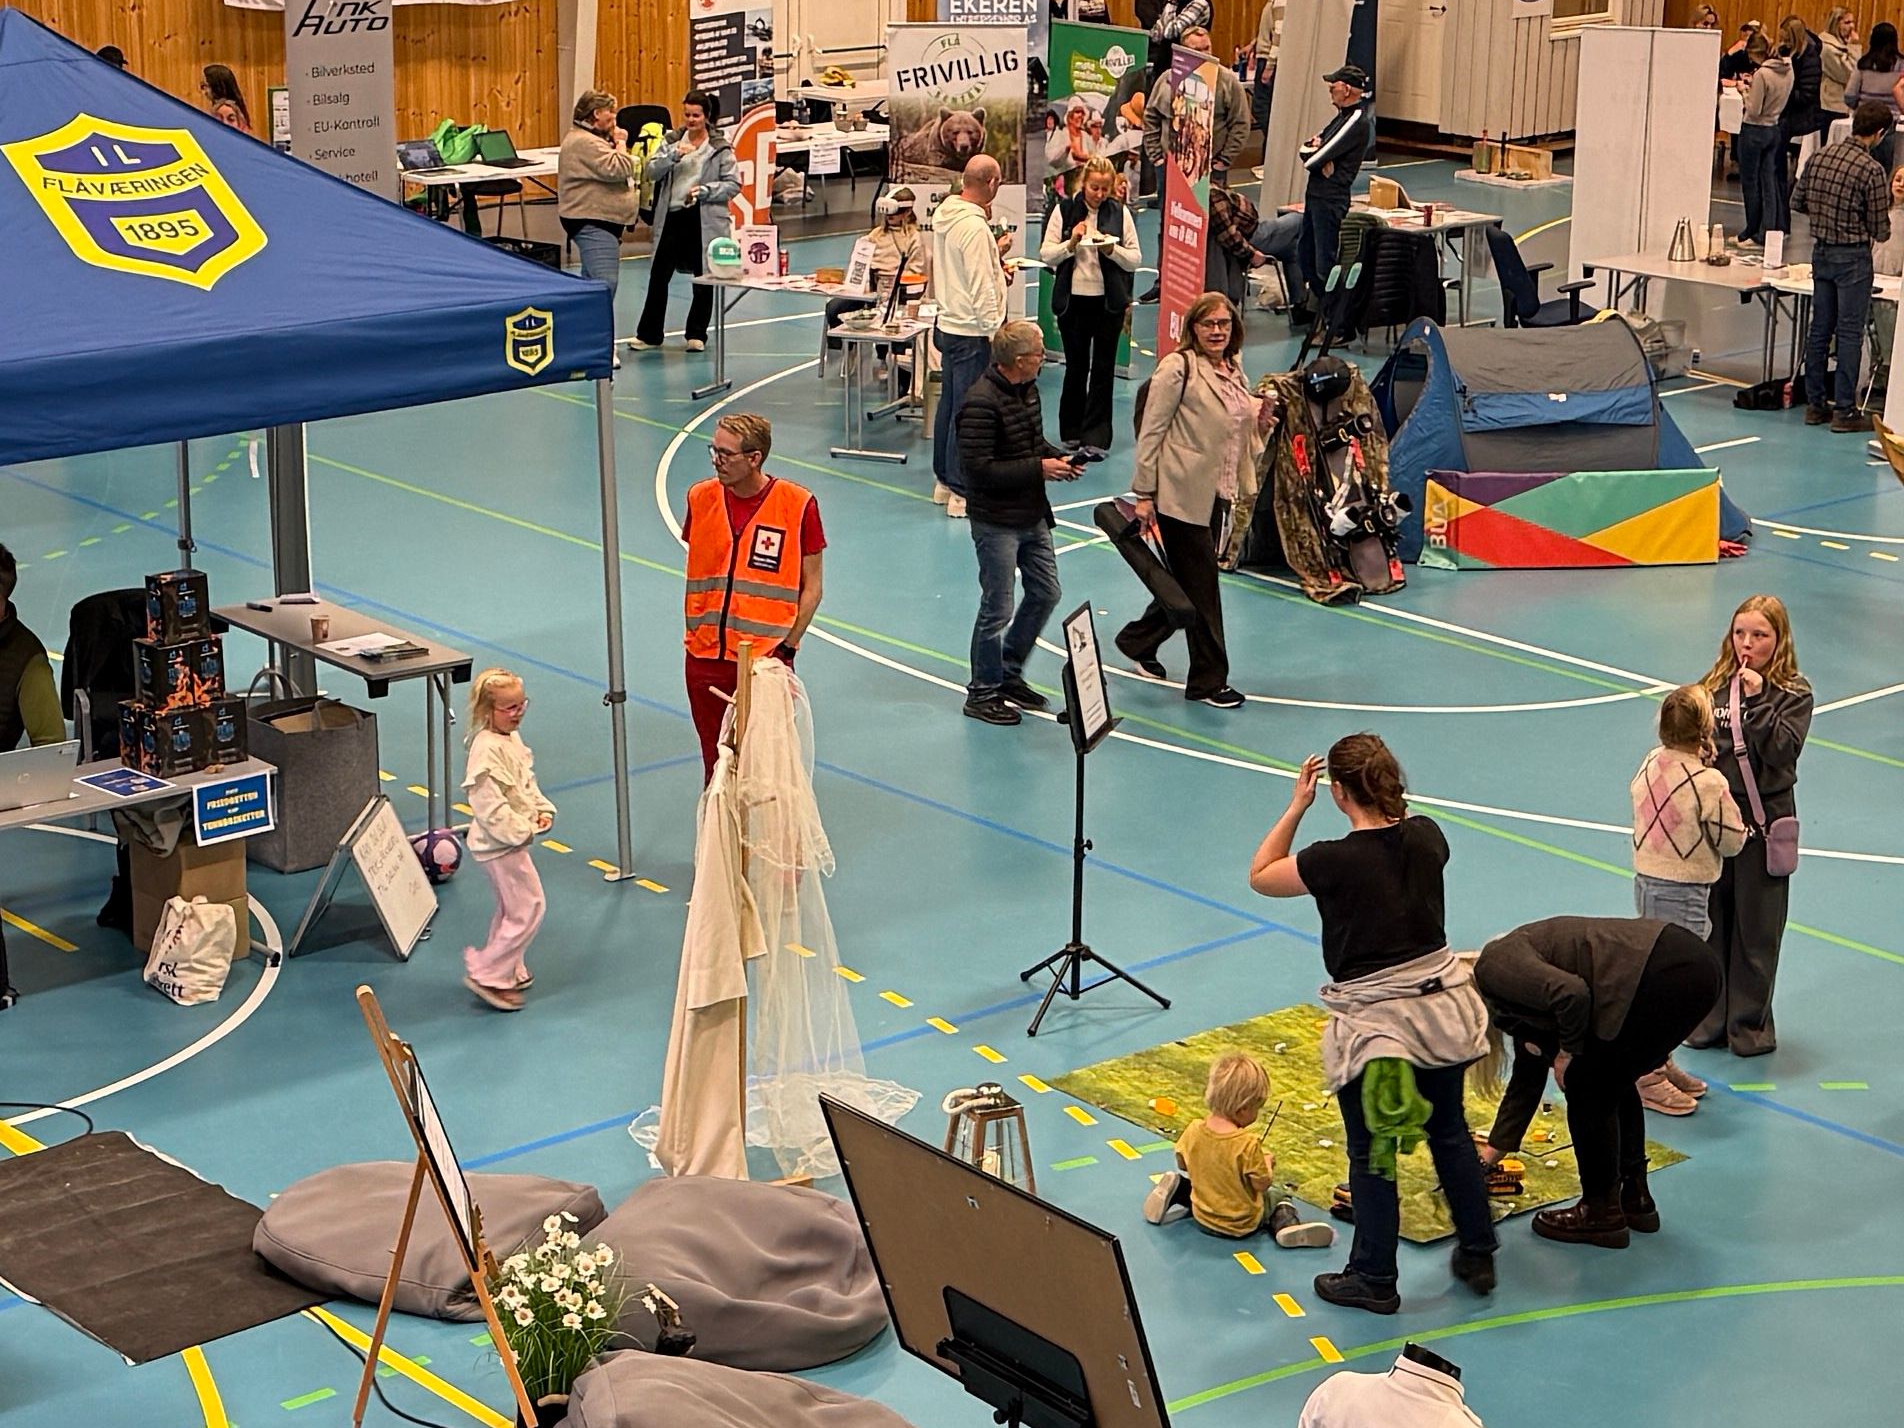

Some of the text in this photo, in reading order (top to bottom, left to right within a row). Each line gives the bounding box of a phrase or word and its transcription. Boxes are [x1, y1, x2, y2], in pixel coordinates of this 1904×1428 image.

[312, 62, 375, 79] Bilverksted
[896, 50, 1019, 92] FRIVILLIG
[312, 92, 350, 106] Bilsalg
[314, 117, 380, 133] EU-Kontroll
[90, 143, 141, 167] IL
[315, 146, 355, 160] Service
[43, 163, 210, 196] FLÅVÆRINGEN
[124, 219, 200, 243] 1895
[1430, 501, 1448, 548] BUA
